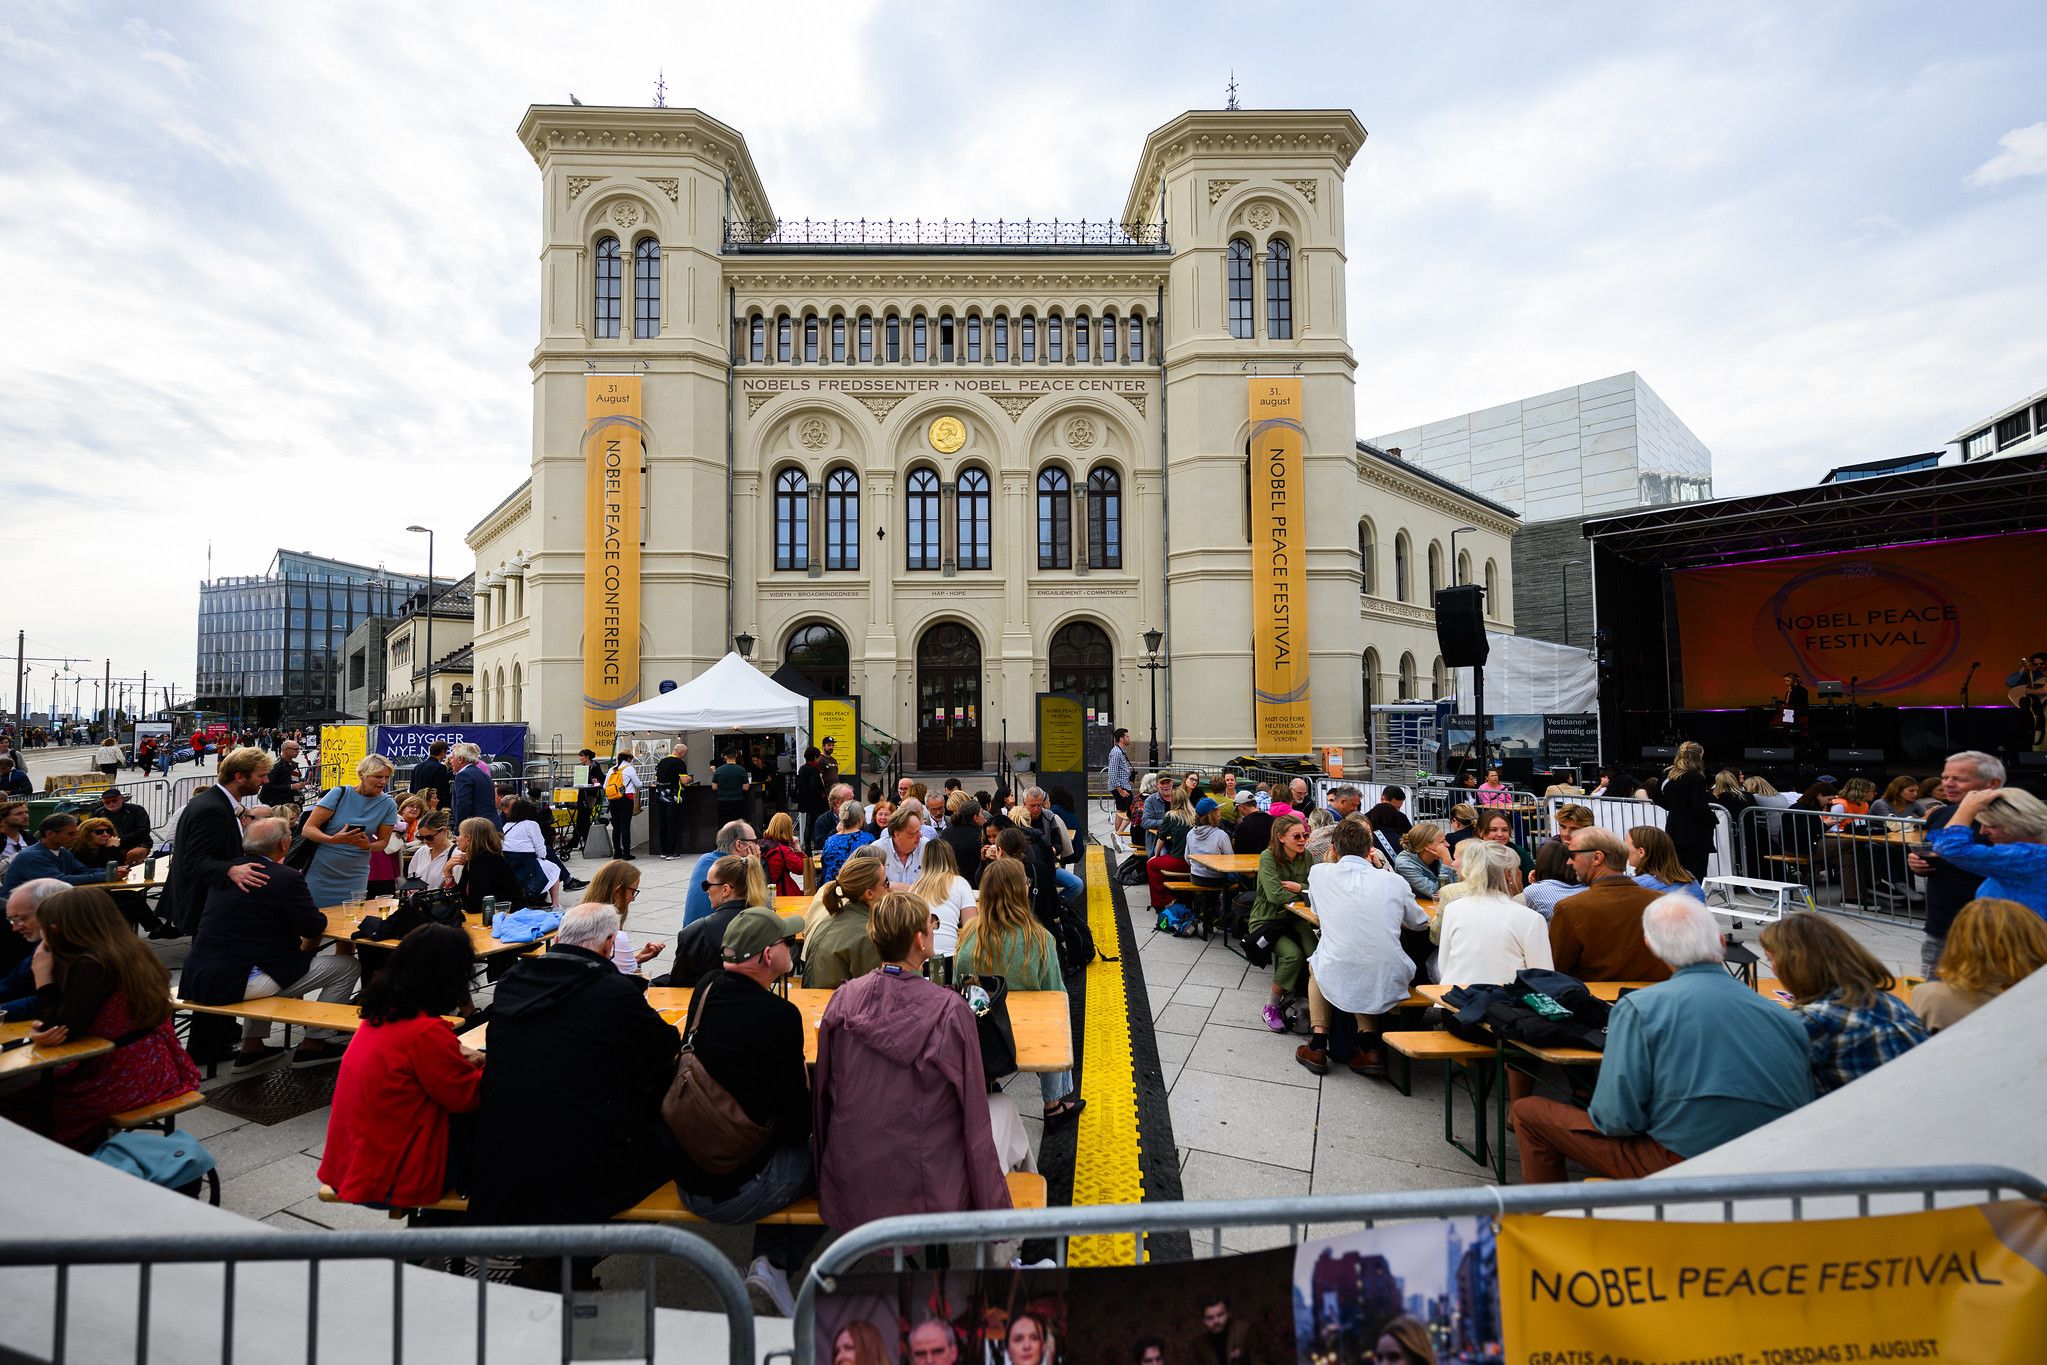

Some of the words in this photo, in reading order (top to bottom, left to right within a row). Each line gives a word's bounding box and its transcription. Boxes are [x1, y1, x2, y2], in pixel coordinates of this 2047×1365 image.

[608, 384, 617, 393] 31
[743, 379, 811, 391] NOBELS
[818, 379, 939, 391] FREDSSENTER
[954, 380, 1012, 391] NOBEL
[1018, 380, 1075, 391] PEACE
[1078, 380, 1146, 391] CENTER
[1269, 387, 1281, 396] 31.
[595, 394, 630, 404] August
[1260, 397, 1290, 407] august
[606, 439, 621, 499] NOBEL
[1269, 447, 1286, 511] NOBEL
[605, 503, 620, 561] PEACE
[1272, 515, 1288, 577] PEACE
[1360, 600, 1385, 612] NOBELS
[1385, 605, 1422, 617] FREDSSENTER
[603, 565, 620, 686] CONFERENCE
[1273, 582, 1291, 671] FESTIVAL
[1777, 612, 1861, 632] NOBEL
[1867, 604, 1958, 626] PEACE
[1805, 630, 1927, 651] FESTIVAL
[594, 720, 616, 728] HUM
[1547, 718, 1587, 726] Vestbanen
[388, 733, 403, 744] VI
[407, 733, 464, 744] BYGGER
[1547, 728, 1585, 736] Innvendig
[386, 746, 416, 757] NYE
[1531, 1267, 1668, 1309] NOBEL
[1679, 1262, 1808, 1299] PEACE
[1818, 1250, 2004, 1294] FESTIVAL
[1529, 1351, 1594, 1365] GRATIS
[1762, 1347, 1842, 1365] TORSDAG
[1844, 1345, 1867, 1360] 31.
[1872, 1339, 1939, 1359] AUGUST
